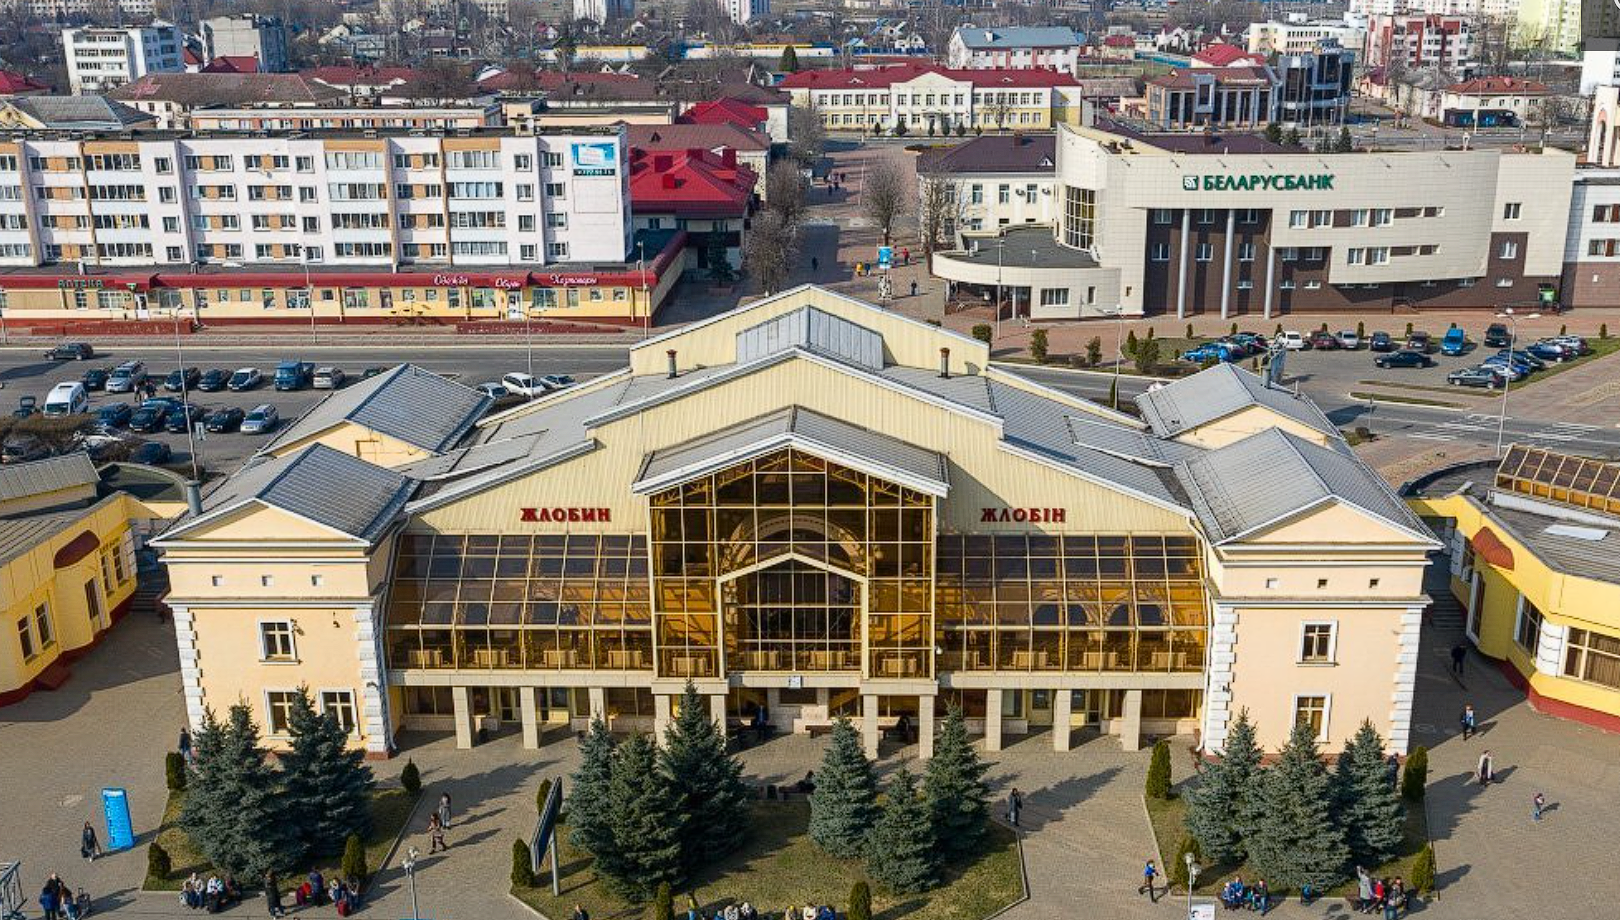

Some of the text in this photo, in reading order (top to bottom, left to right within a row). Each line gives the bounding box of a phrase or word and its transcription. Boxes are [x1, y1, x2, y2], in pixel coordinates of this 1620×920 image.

[1203, 174, 1335, 191] БЕЛАРУСБАНК
[520, 507, 612, 522] ЖЛОБИН
[980, 508, 1067, 523] ЖЛОБІН
